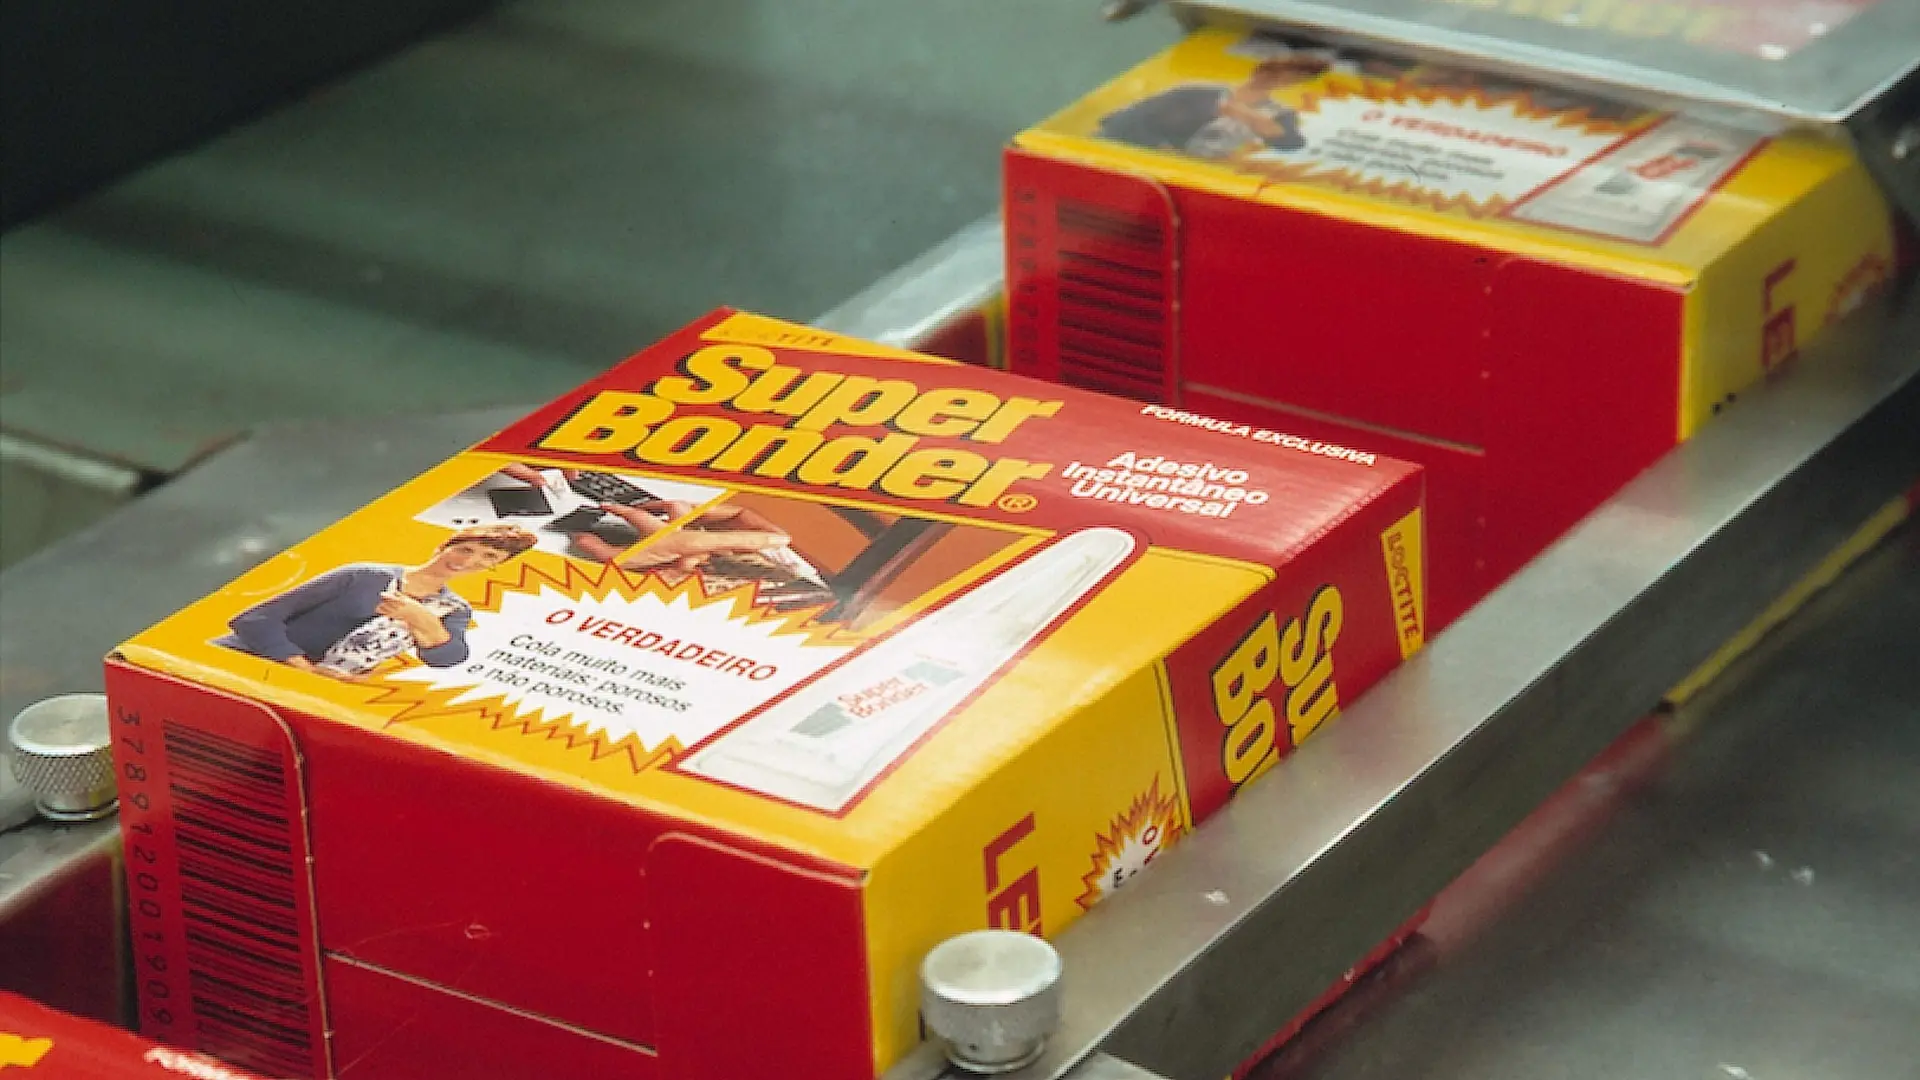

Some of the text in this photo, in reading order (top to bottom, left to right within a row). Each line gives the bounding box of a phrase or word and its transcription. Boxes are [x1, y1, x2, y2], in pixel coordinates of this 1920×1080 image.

[645, 344, 1064, 443] Super
[533, 390, 1053, 507] Bonder
[1140, 403, 1377, 466] FORMULA EXCLUSIVA
[1061, 461, 1270, 505] Instantâneo
[1107, 451, 1249, 484] Adesivo
[1070, 479, 1238, 518] Universal
[509, 633, 688, 692] Cola muito mais
[545, 608, 778, 682] O VERDADEIRO
[1279, 583, 1344, 748] Su
[466, 663, 485, 675] e
[485, 665, 530, 688] não
[594, 679, 693, 714] porosos
